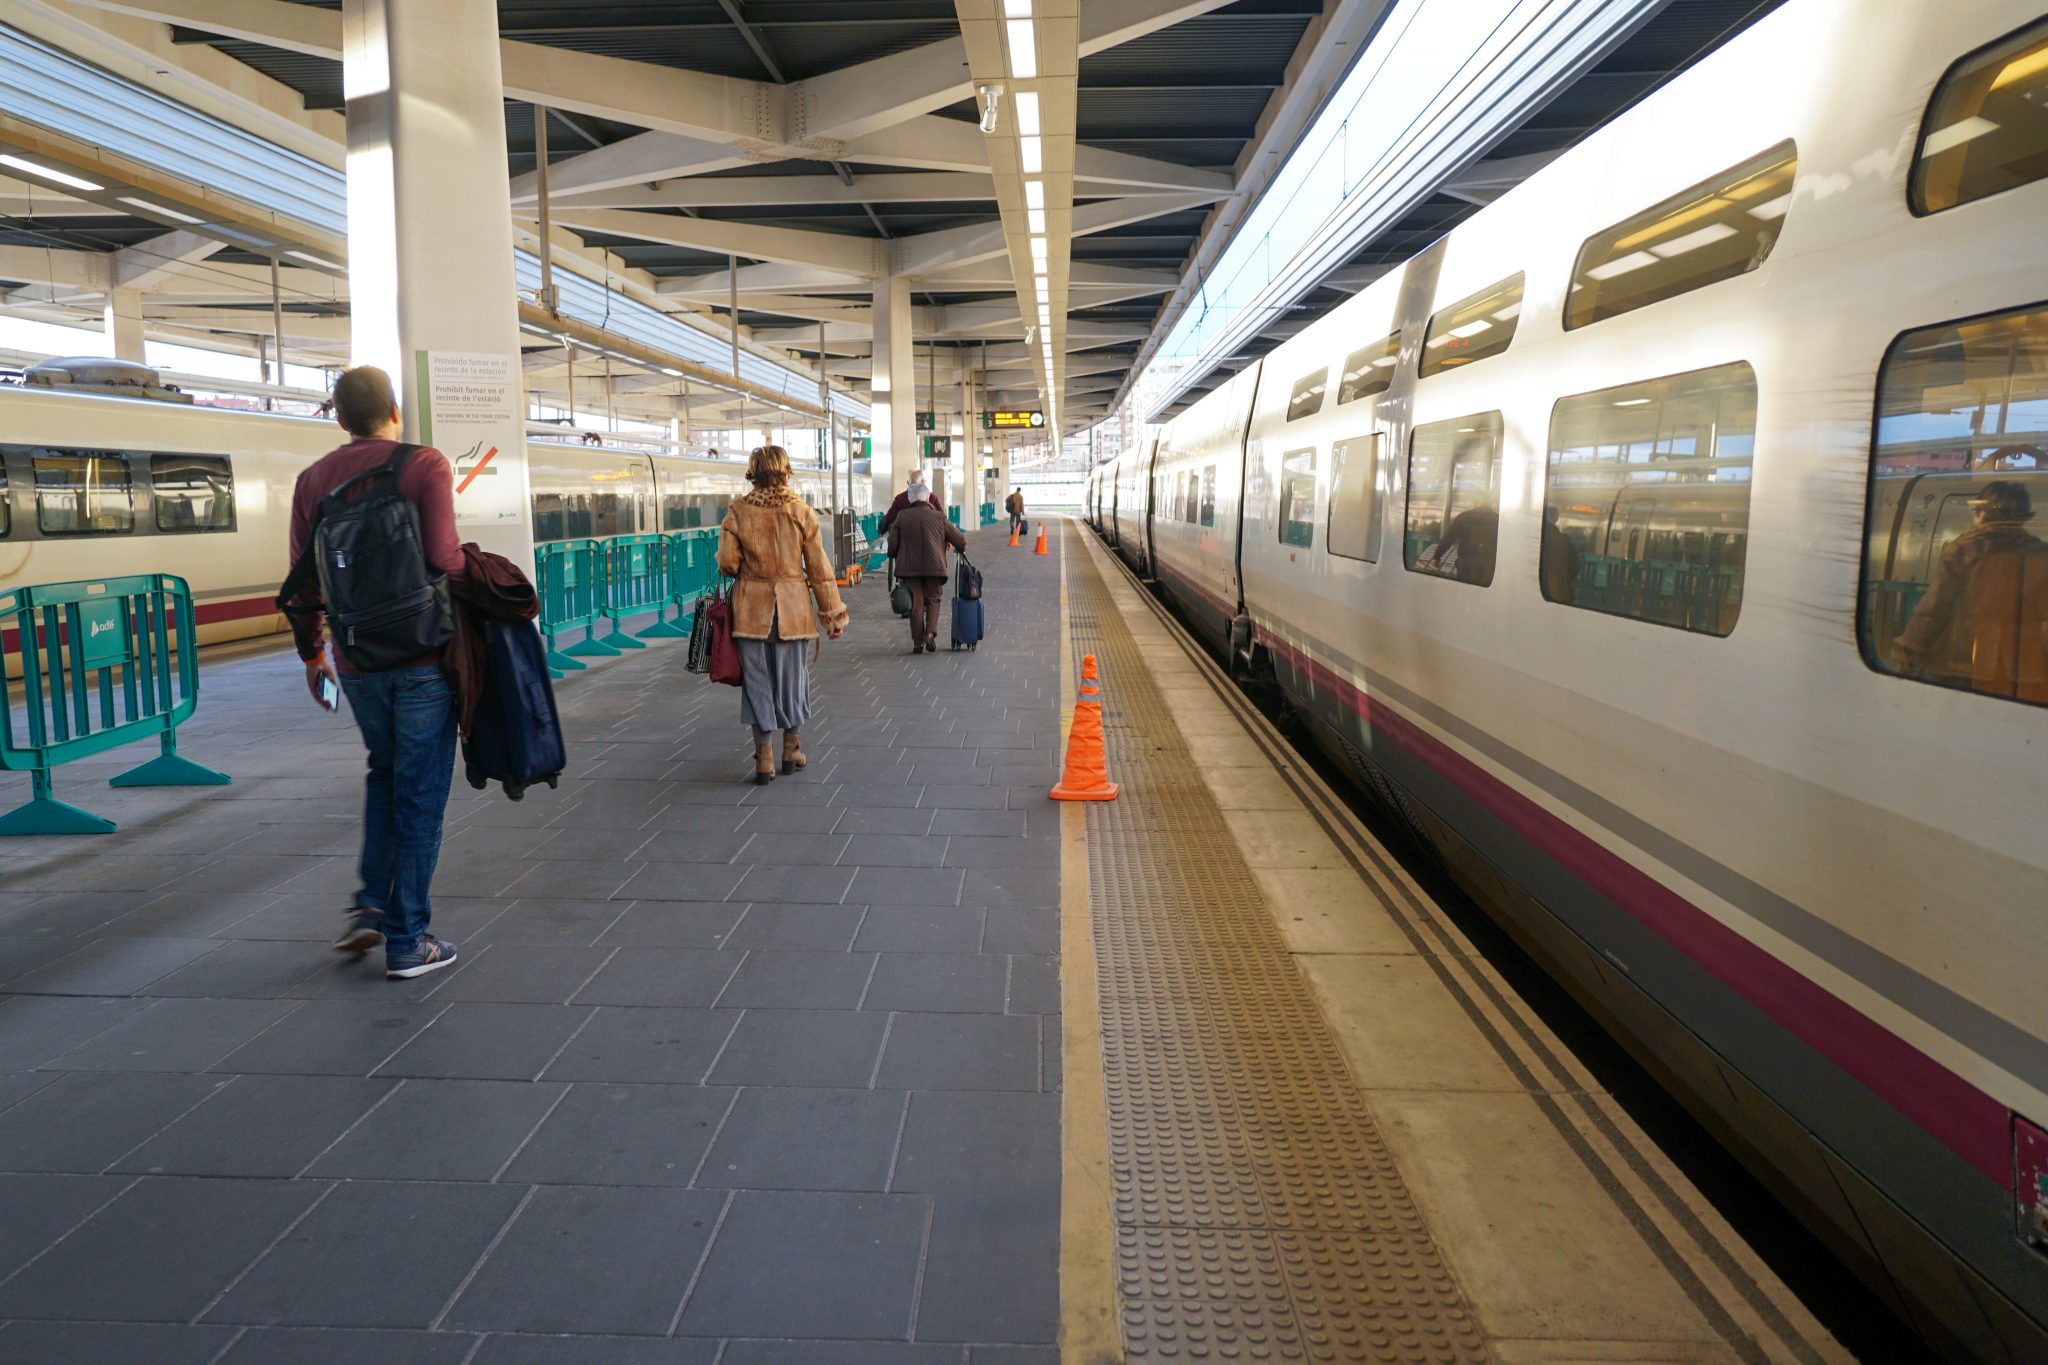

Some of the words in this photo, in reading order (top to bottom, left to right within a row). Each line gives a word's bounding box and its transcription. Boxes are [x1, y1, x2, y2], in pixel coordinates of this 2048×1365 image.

[434, 356, 467, 366] Prohibido
[469, 358, 488, 366] fumar
[502, 360, 508, 368] el
[479, 367, 506, 375] estación
